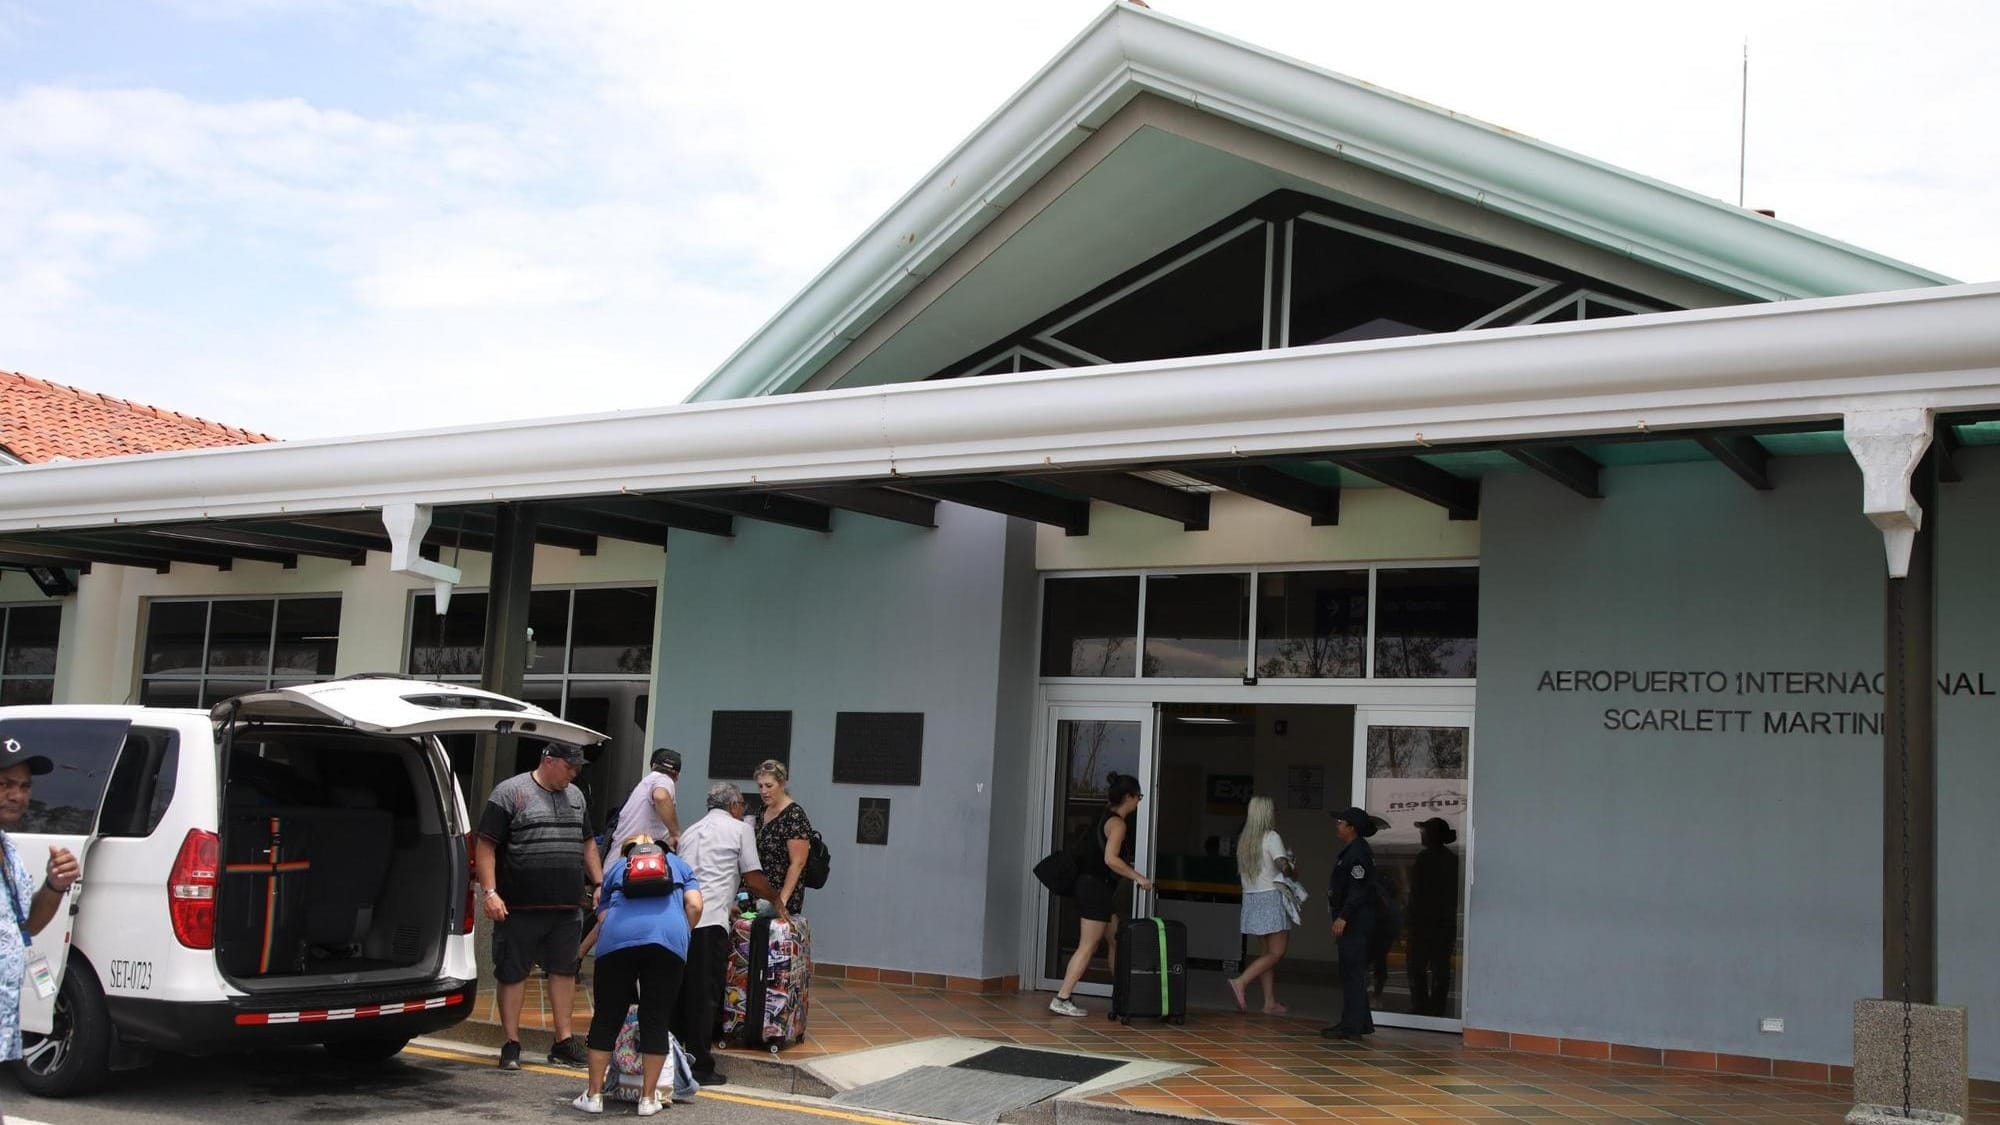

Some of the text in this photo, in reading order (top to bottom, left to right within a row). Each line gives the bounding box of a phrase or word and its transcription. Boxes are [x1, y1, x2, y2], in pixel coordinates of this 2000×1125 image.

[1537, 670, 1996, 695] AEROPUERTO INTERNACNAL
[1604, 708, 1884, 734] SCARLETT MARTIN
[111, 960, 152, 990] SET-0723
